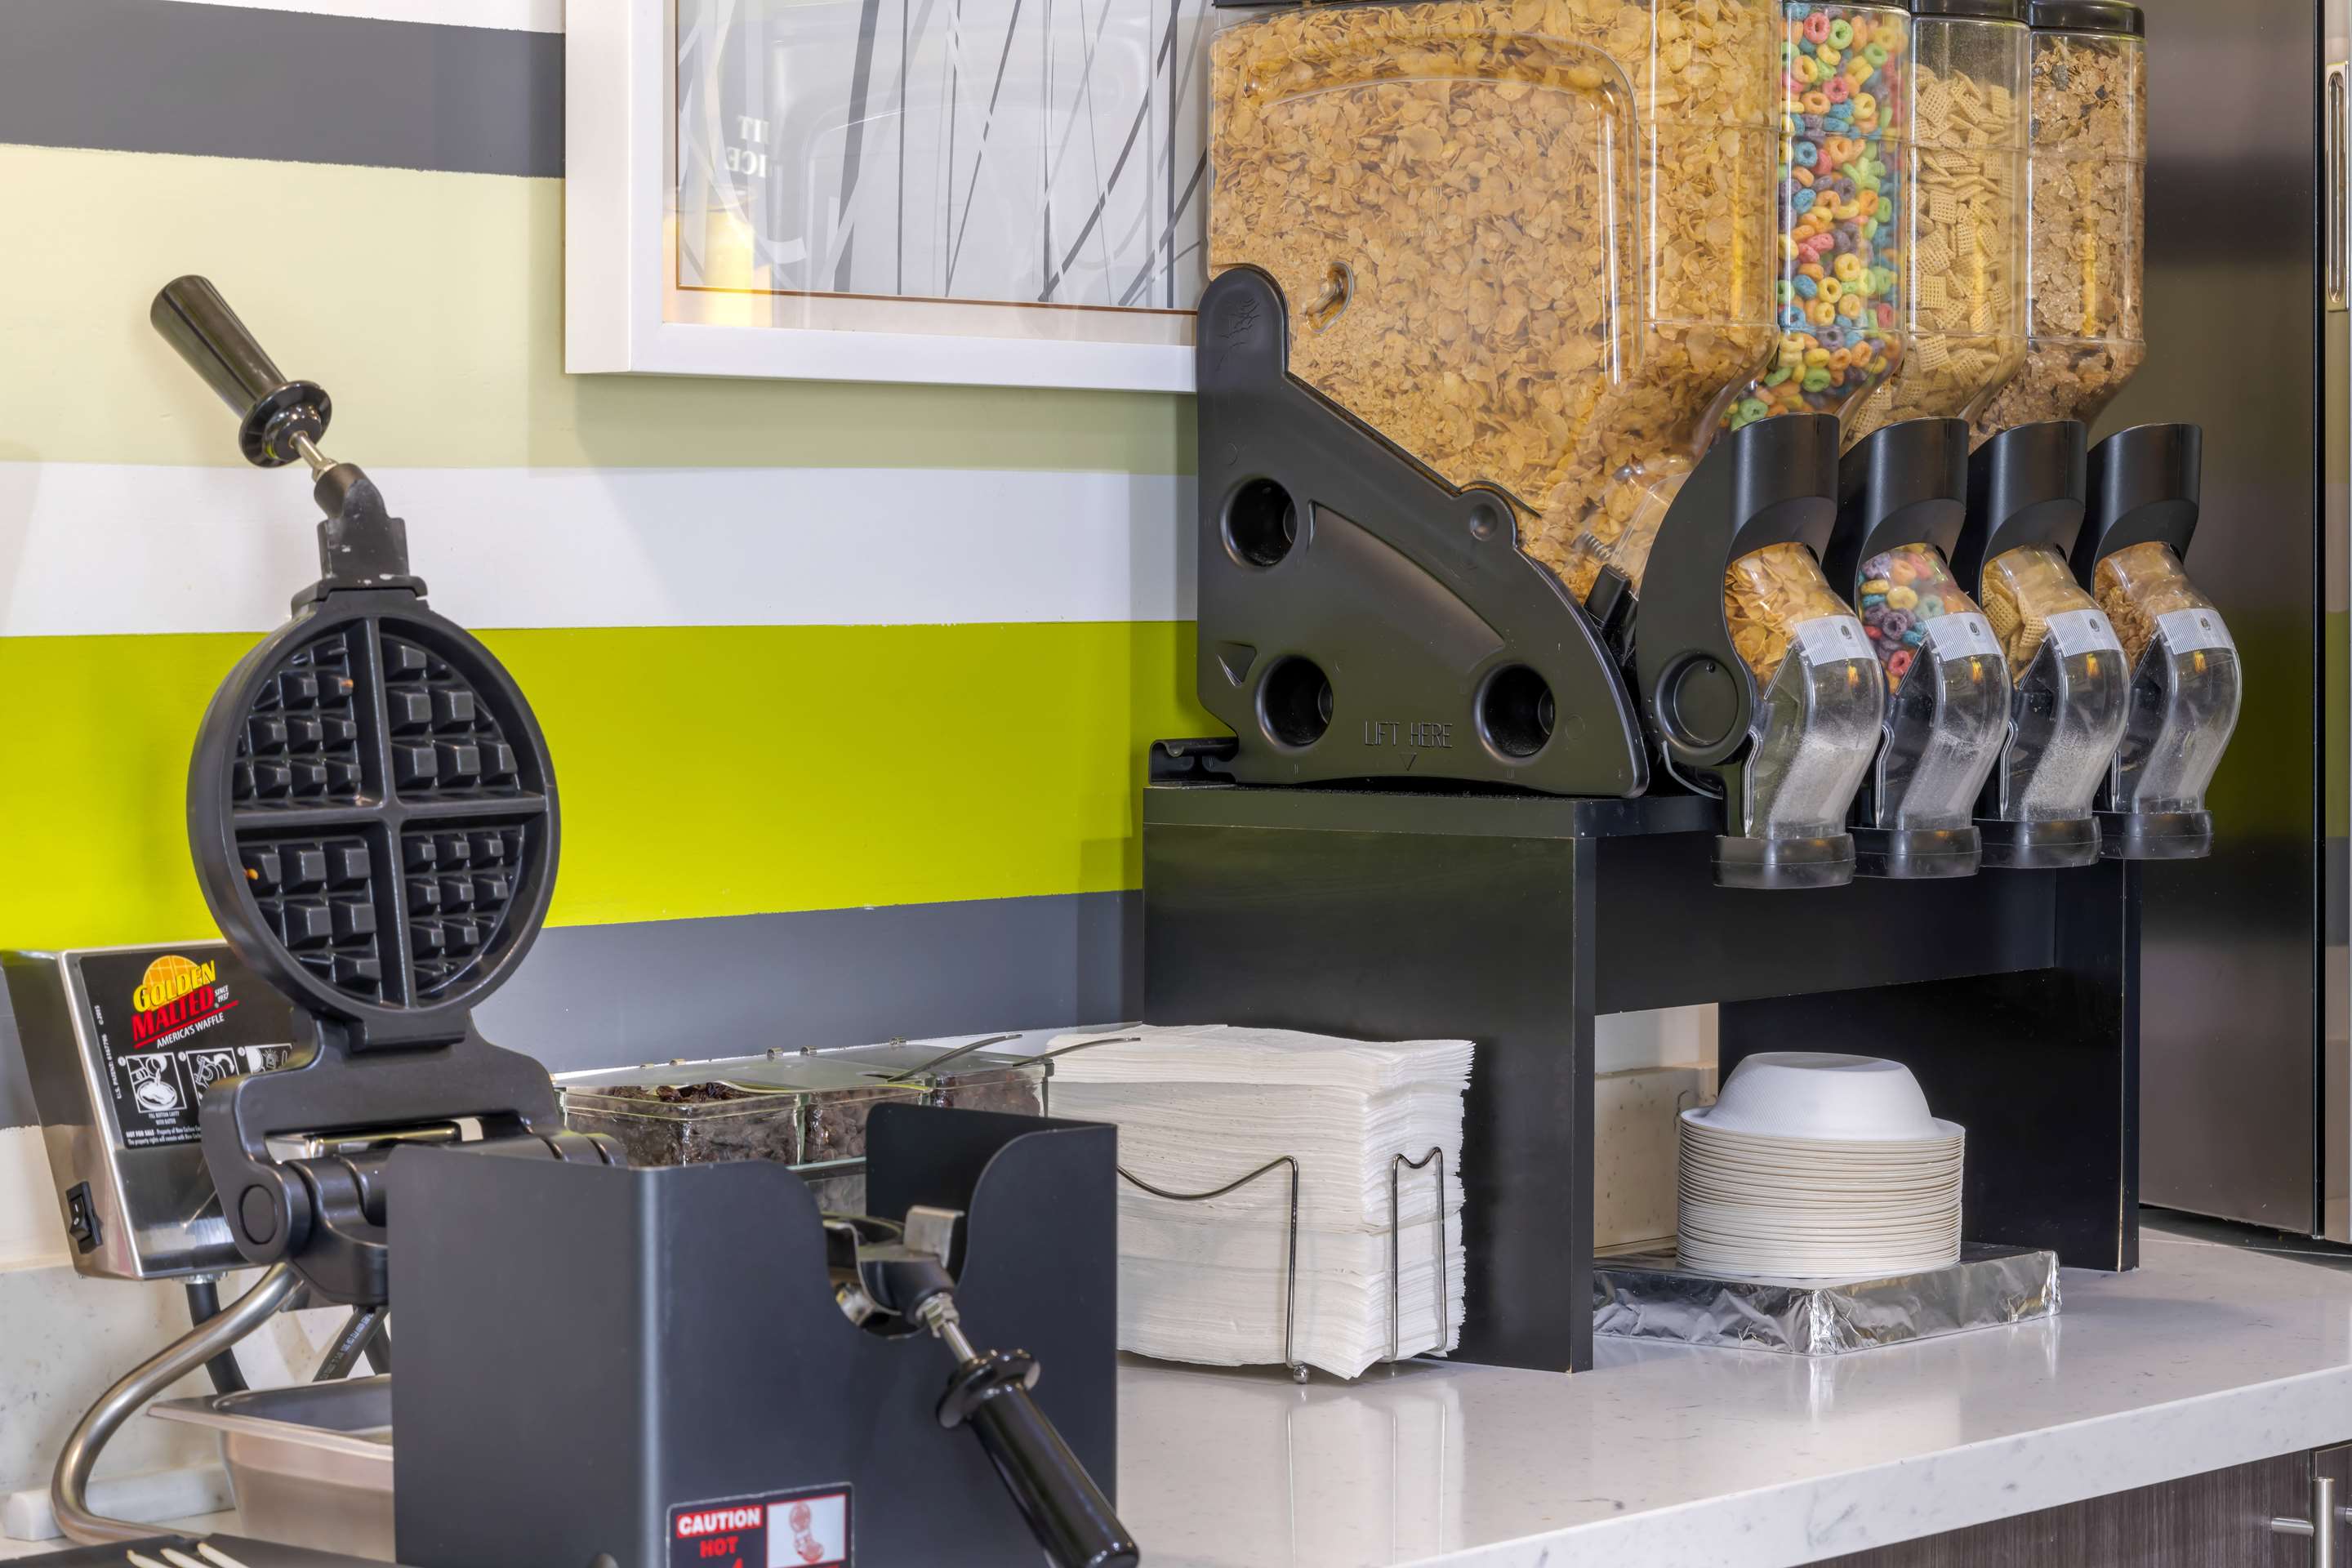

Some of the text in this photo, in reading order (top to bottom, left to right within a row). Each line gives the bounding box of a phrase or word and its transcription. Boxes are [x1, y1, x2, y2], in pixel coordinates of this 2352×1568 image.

[1365, 721, 1453, 748] LIFT HERE
[133, 960, 216, 1012] GOLDEN
[215, 985, 229, 997] SINCE
[217, 992, 229, 1003] 1937
[131, 985, 215, 1041] MALTED
[157, 1012, 225, 1049] AMERICA'S WAFFLE
[678, 1508, 761, 1535] CAUTION
[700, 1536, 739, 1558] HOT
